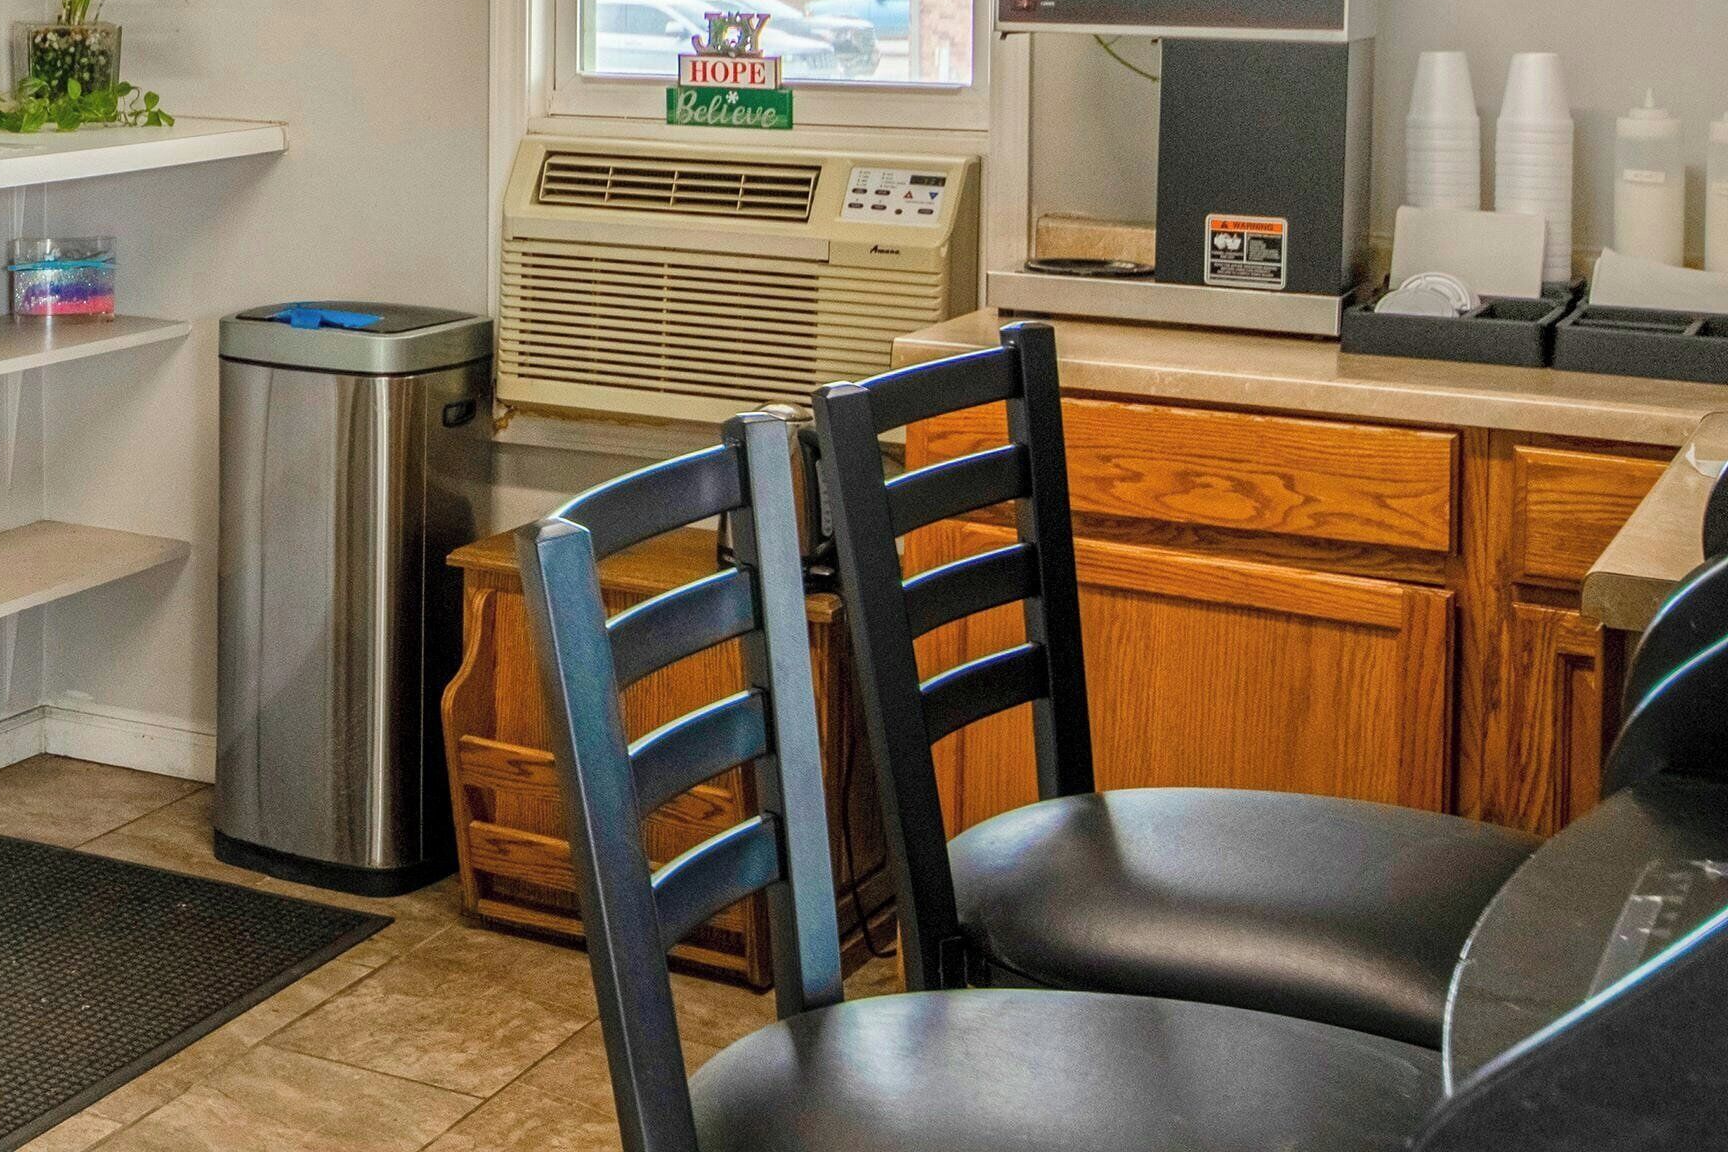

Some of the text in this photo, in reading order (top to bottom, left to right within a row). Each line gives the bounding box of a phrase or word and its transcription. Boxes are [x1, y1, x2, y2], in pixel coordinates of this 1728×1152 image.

[690, 60, 766, 85] HOPE
[676, 90, 778, 128] Believe
[1232, 221, 1274, 232] WARNING
[870, 244, 900, 255] Amana
